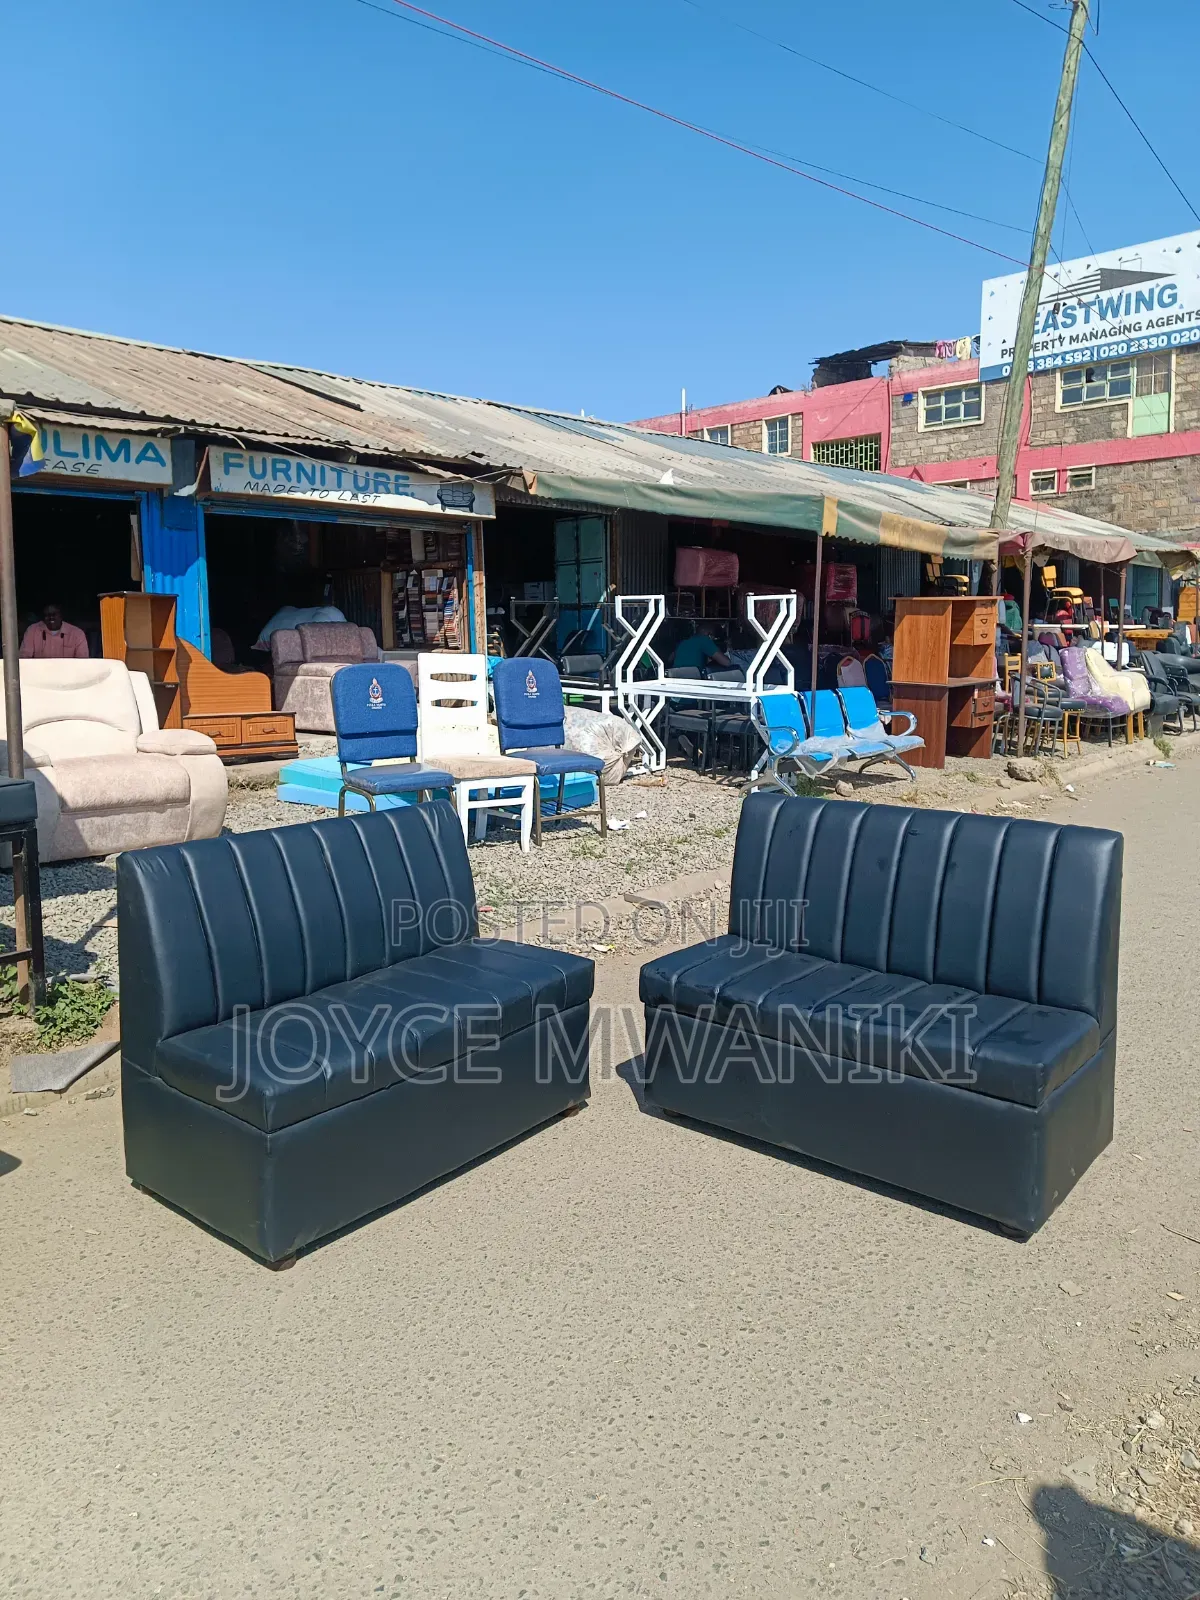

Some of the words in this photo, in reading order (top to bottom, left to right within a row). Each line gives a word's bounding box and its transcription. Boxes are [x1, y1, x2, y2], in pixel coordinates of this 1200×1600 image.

[1001, 337, 1066, 359] PRERTY
[1069, 322, 1142, 345] MANAGING
[1146, 309, 1200, 330] AGENTS
[1002, 361, 1034, 376] 03
[1037, 355, 1063, 370] 384
[1065, 349, 1091, 364] 592
[1100, 343, 1128, 357] 020
[1130, 335, 1168, 352] 2330
[1171, 329, 1200, 345] 020
[41, 428, 166, 467] ILIMA
[244, 481, 300, 495] MADE
[310, 487, 330, 499] TO
[337, 490, 381, 504] LAST
